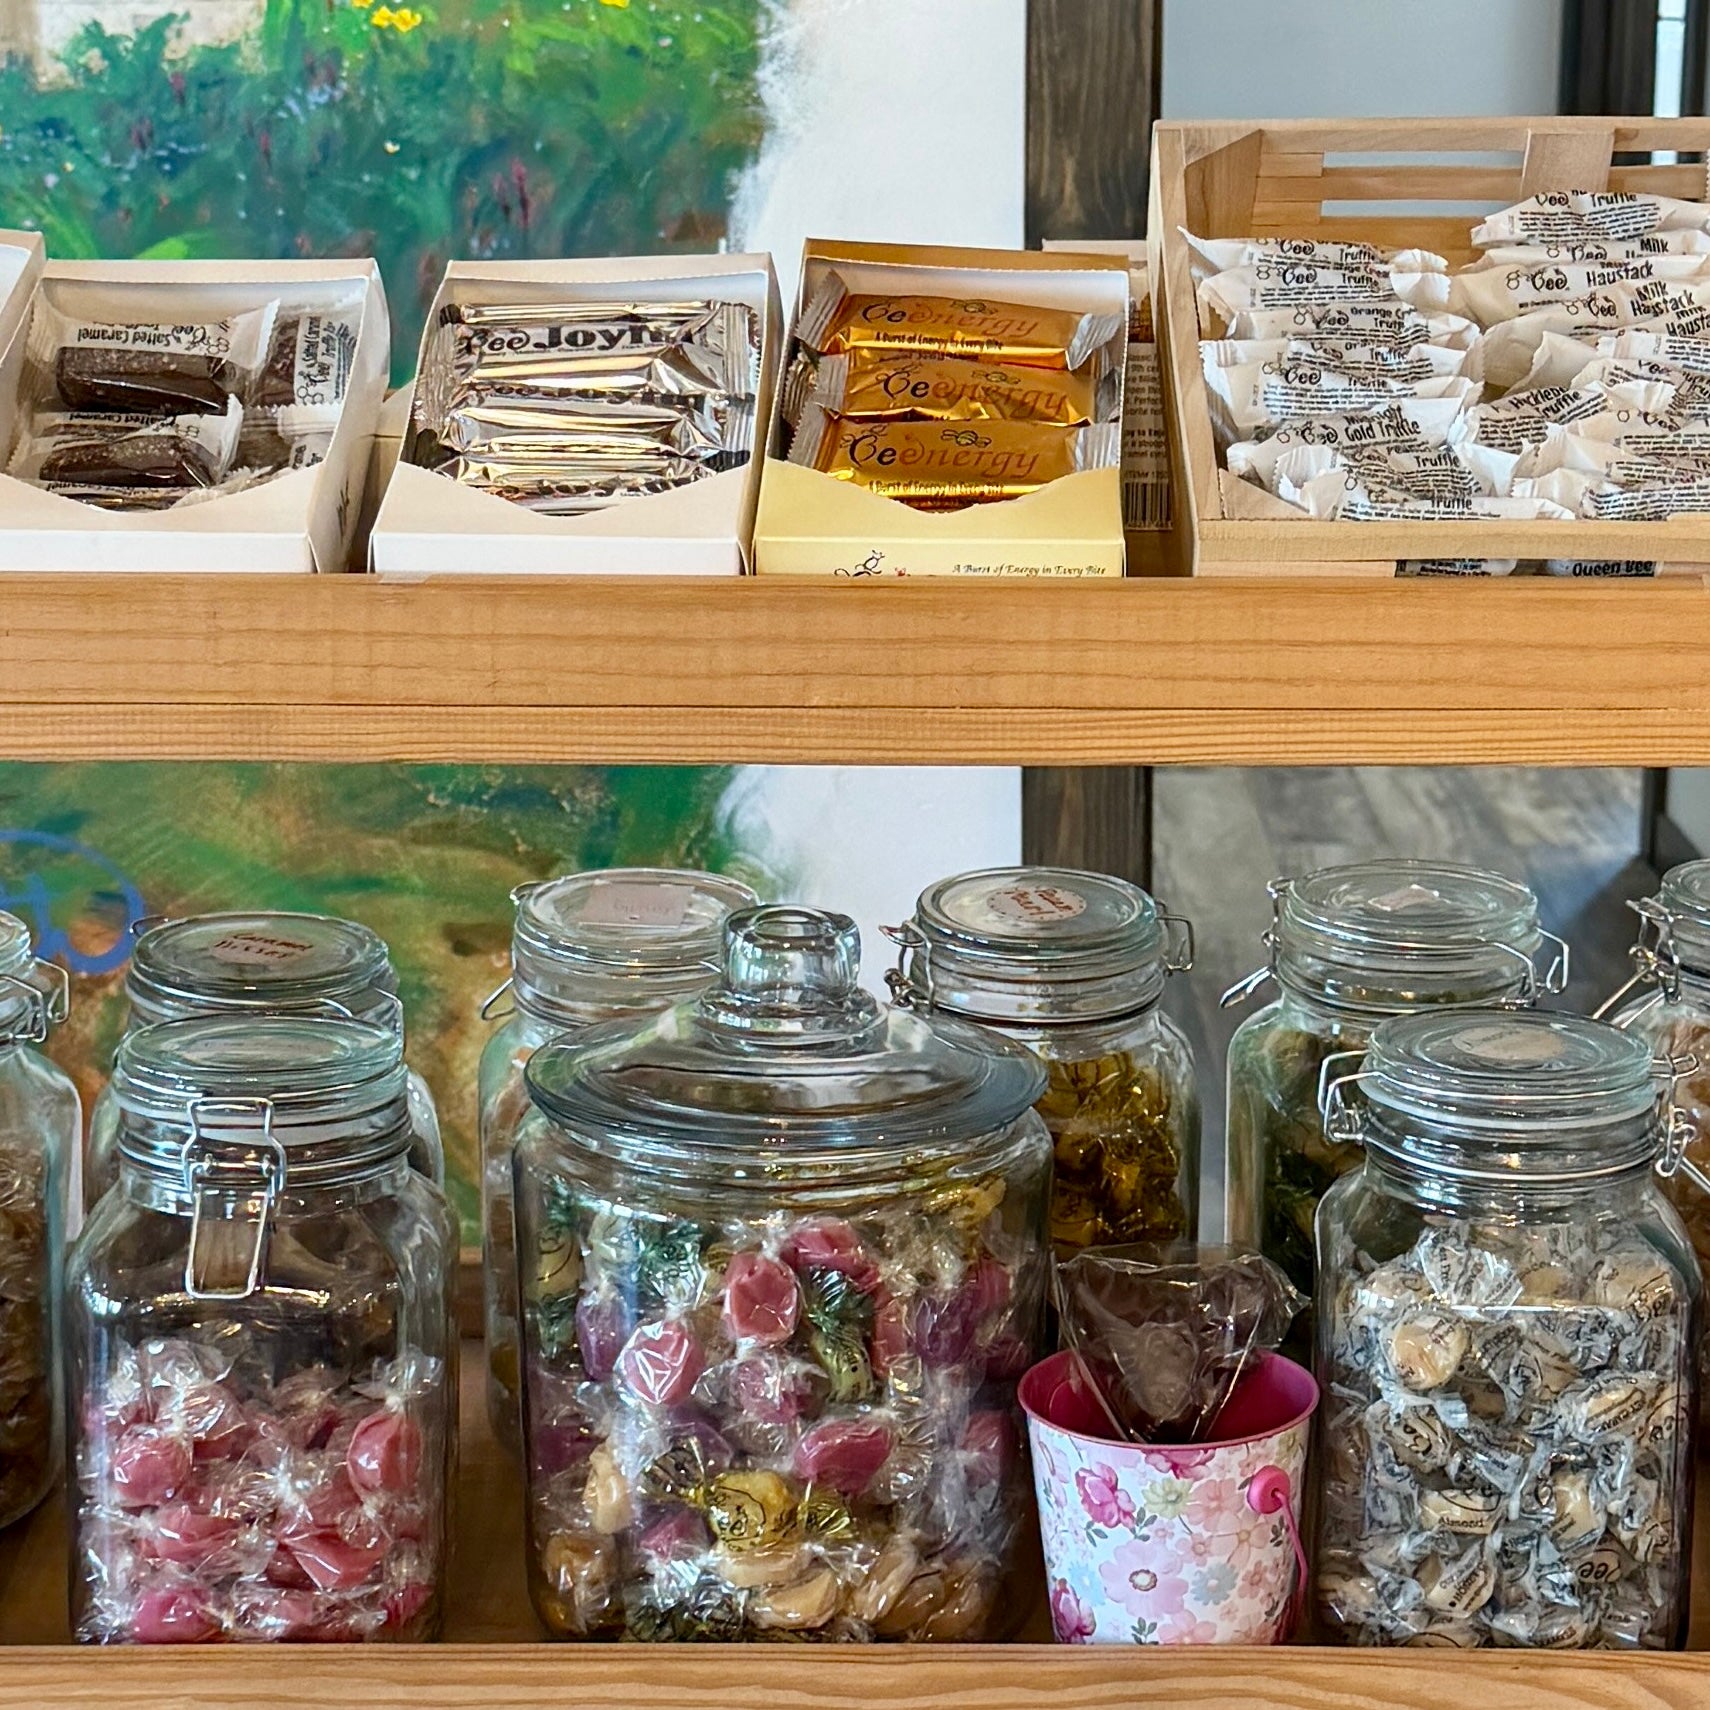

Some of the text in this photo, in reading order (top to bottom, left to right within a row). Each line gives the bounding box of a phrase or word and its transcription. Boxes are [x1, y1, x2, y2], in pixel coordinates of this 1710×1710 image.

[1640, 238, 1669, 253] Milk
[1636, 281, 1669, 301] Milk
[1351, 306, 1392, 318] Orange
[78, 328, 172, 347] Salted Caramel
[1345, 423, 1376, 441] Gold
[849, 432, 1039, 479] Beenergy
[1414, 451, 1460, 468] Truffle
[952, 564, 961, 573] A
[963, 564, 990, 574] Burst
[993, 563, 1005, 577] of
[1006, 565, 1039, 577] Energy
[1054, 565, 1083, 577] Every
[1572, 561, 1621, 577] Queen
[1438, 1515, 1484, 1529] Almond
